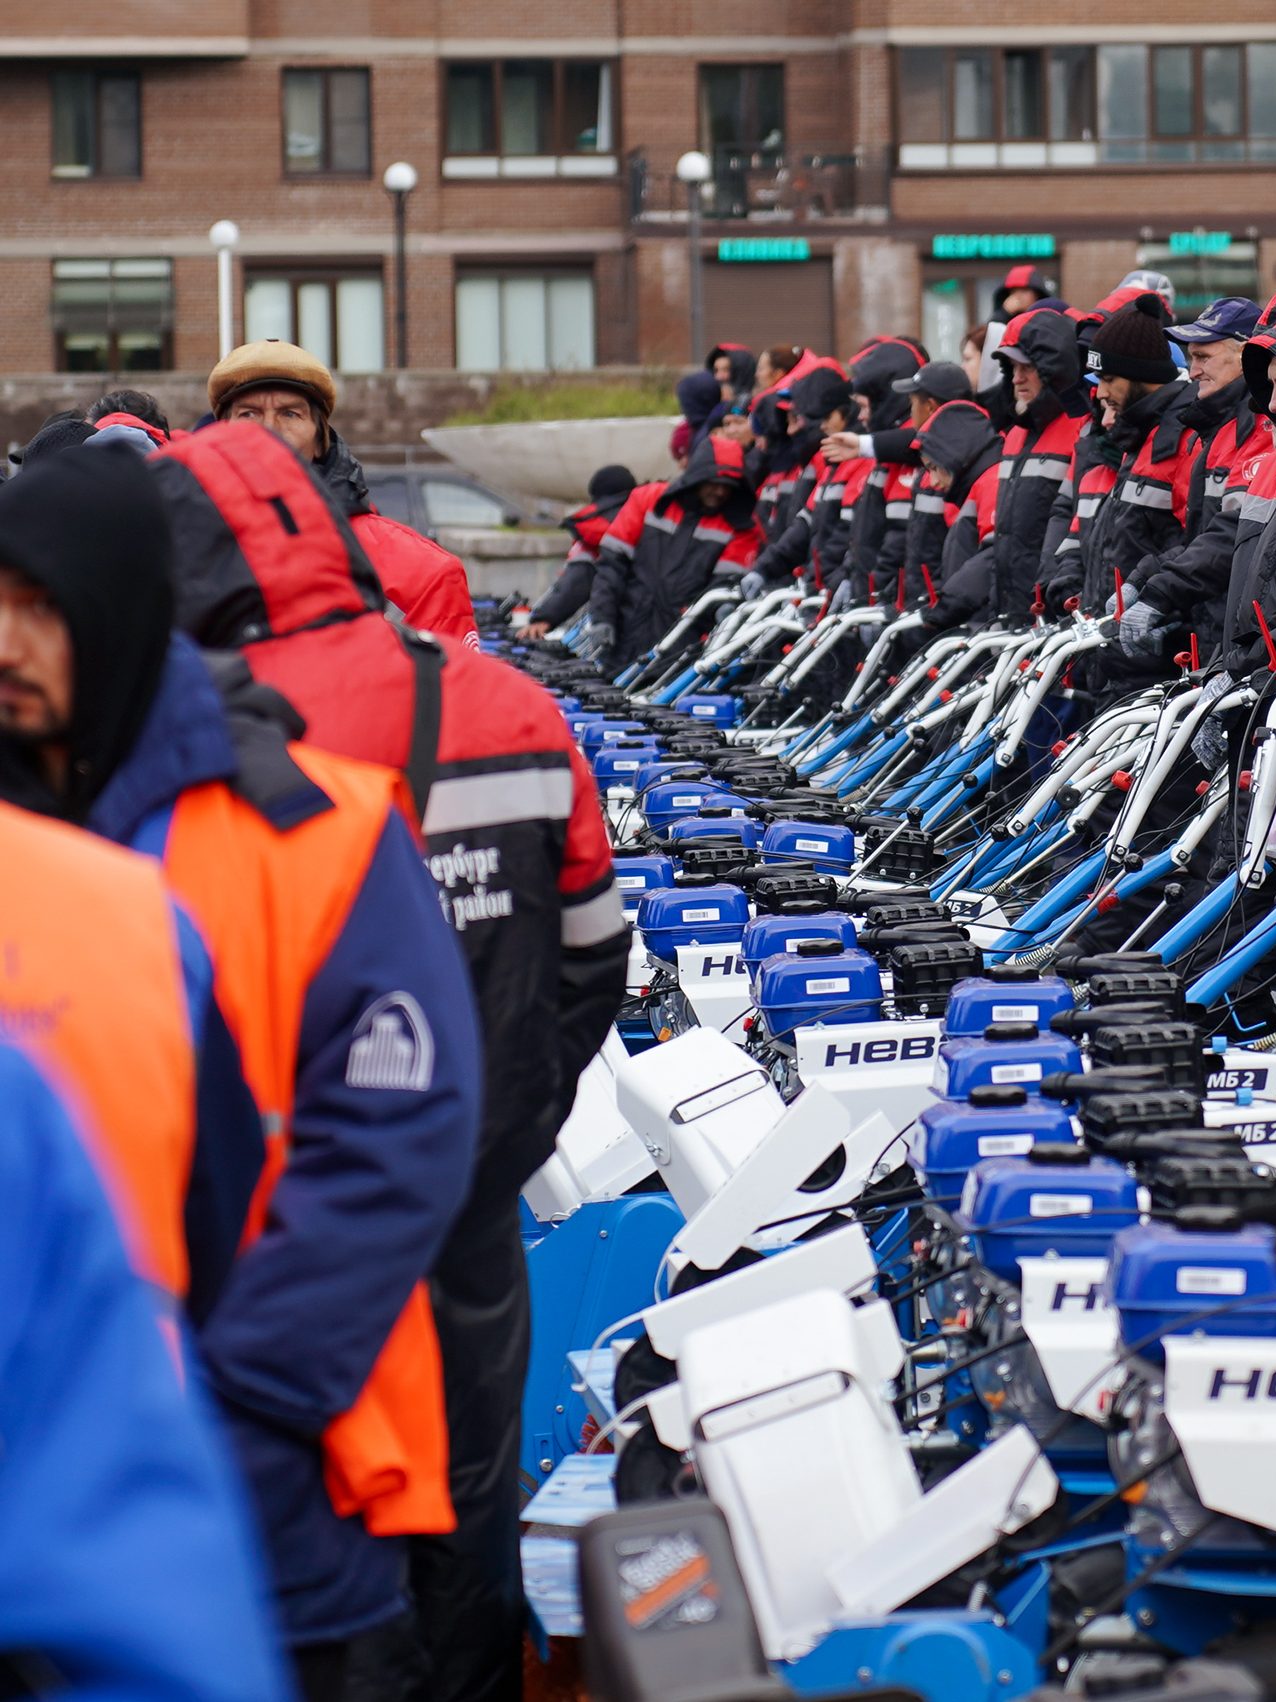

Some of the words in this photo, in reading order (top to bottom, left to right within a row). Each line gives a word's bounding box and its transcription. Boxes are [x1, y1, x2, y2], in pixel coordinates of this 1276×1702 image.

[422, 842, 500, 887] ербург
[1207, 1071, 1239, 1089] МБ
[1241, 1070, 1256, 1088] 2
[1234, 1123, 1267, 1143] МБ
